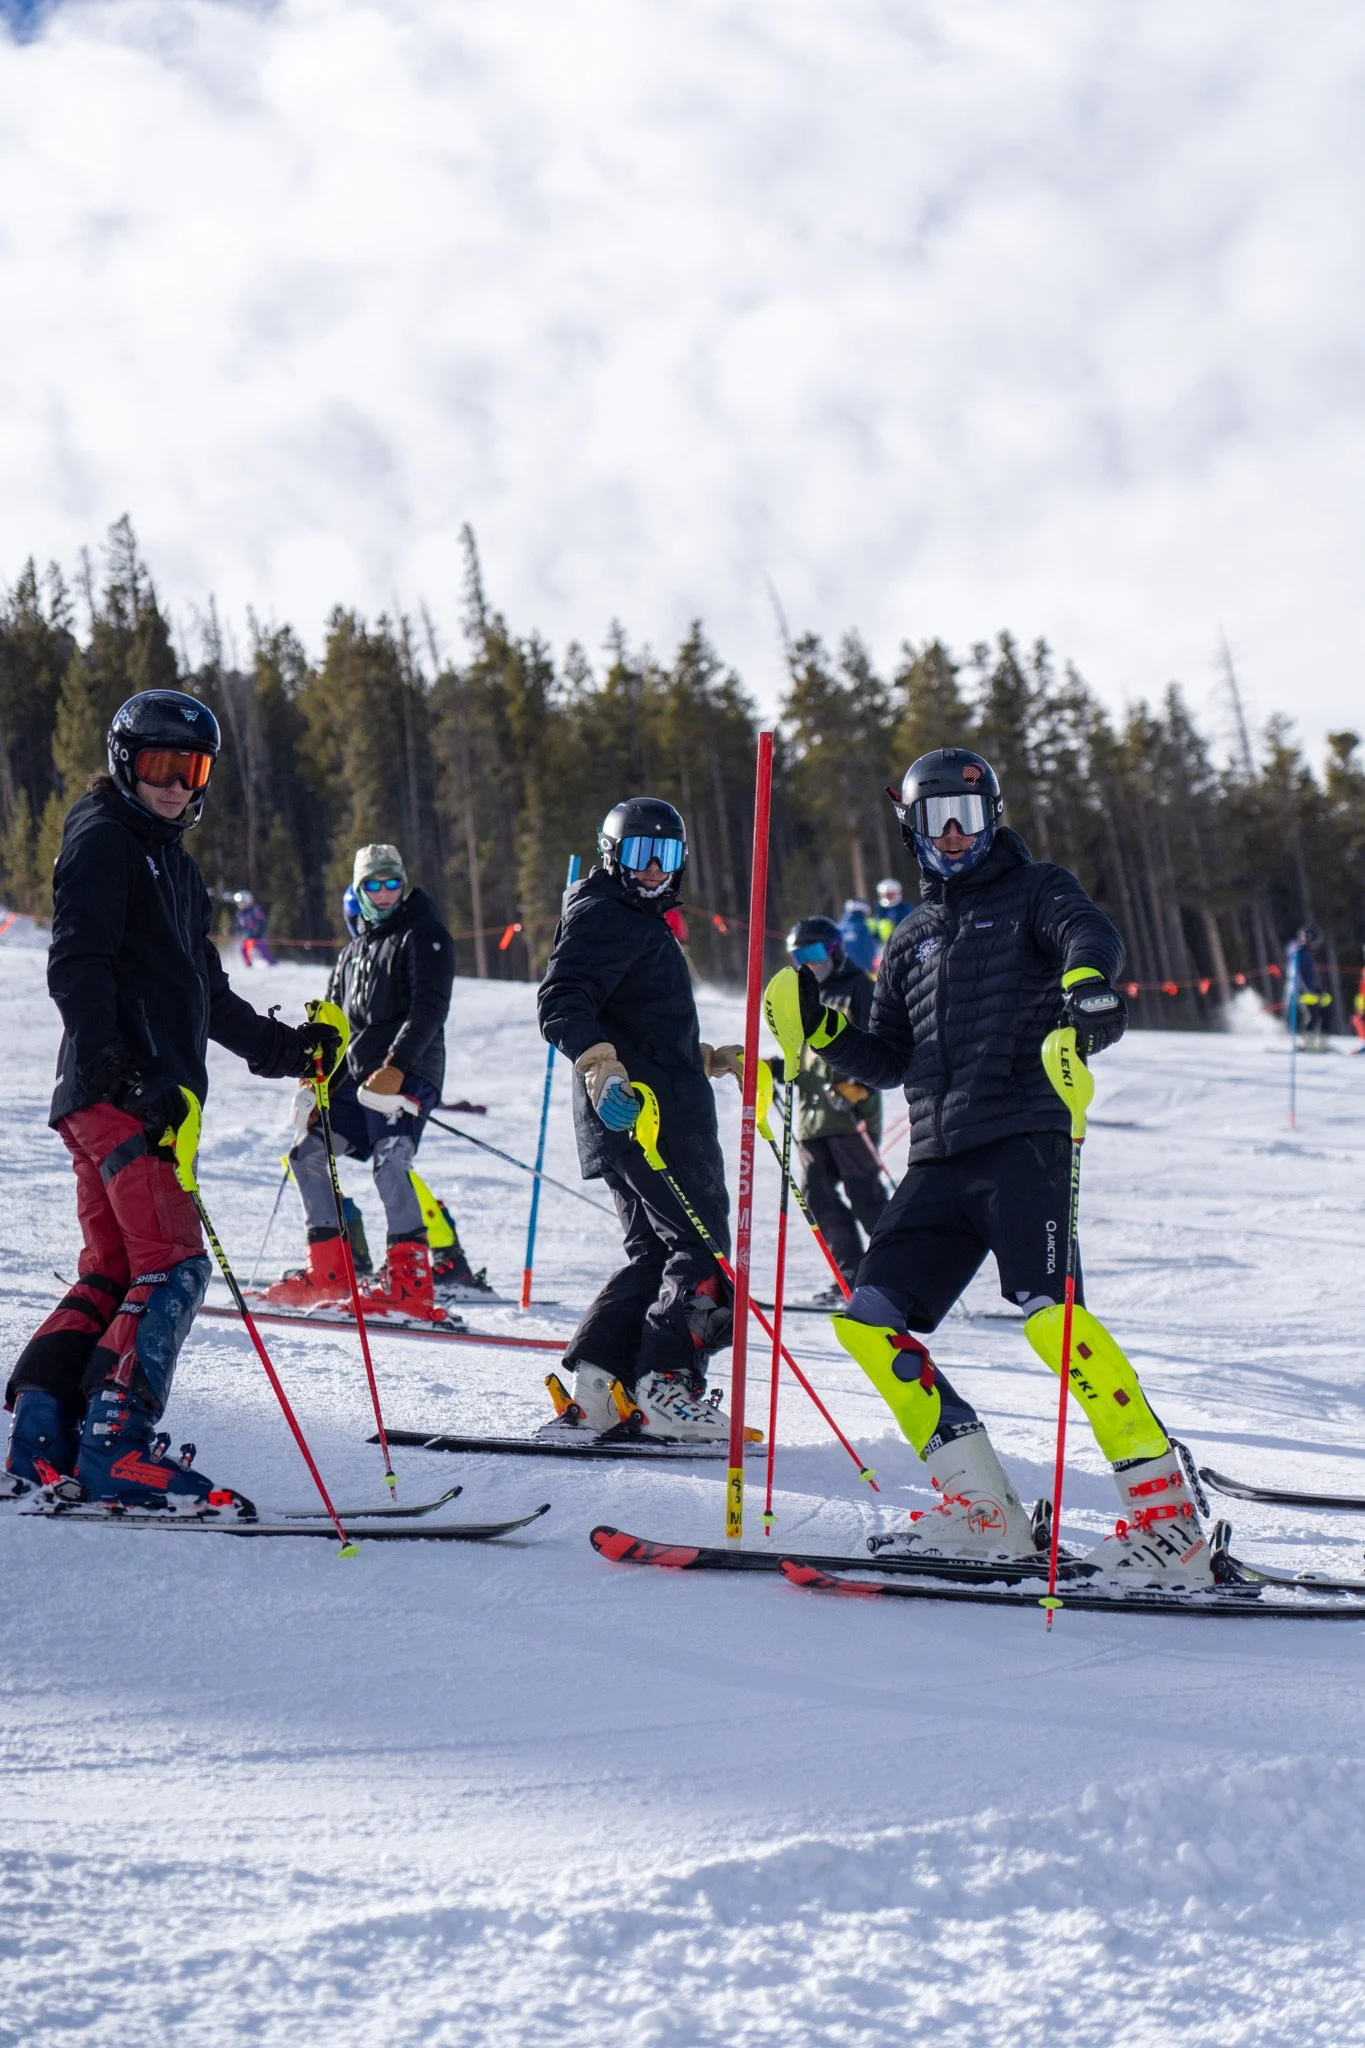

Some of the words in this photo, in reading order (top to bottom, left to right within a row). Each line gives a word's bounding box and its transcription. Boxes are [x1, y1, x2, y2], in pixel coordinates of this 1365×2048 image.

[766, 1000, 780, 1037] LEKI
[1087, 997, 1115, 1008] LEKI
[1060, 1047, 1074, 1088] LEKI
[649, 1091, 659, 1126] LEKI
[789, 1180, 807, 1210] LEKI
[685, 1208, 711, 1240] LEKI
[208, 1234, 231, 1273] LEKI
[1046, 1233, 1057, 1275] ARCTICA
[1069, 1367, 1098, 1400] EKI
